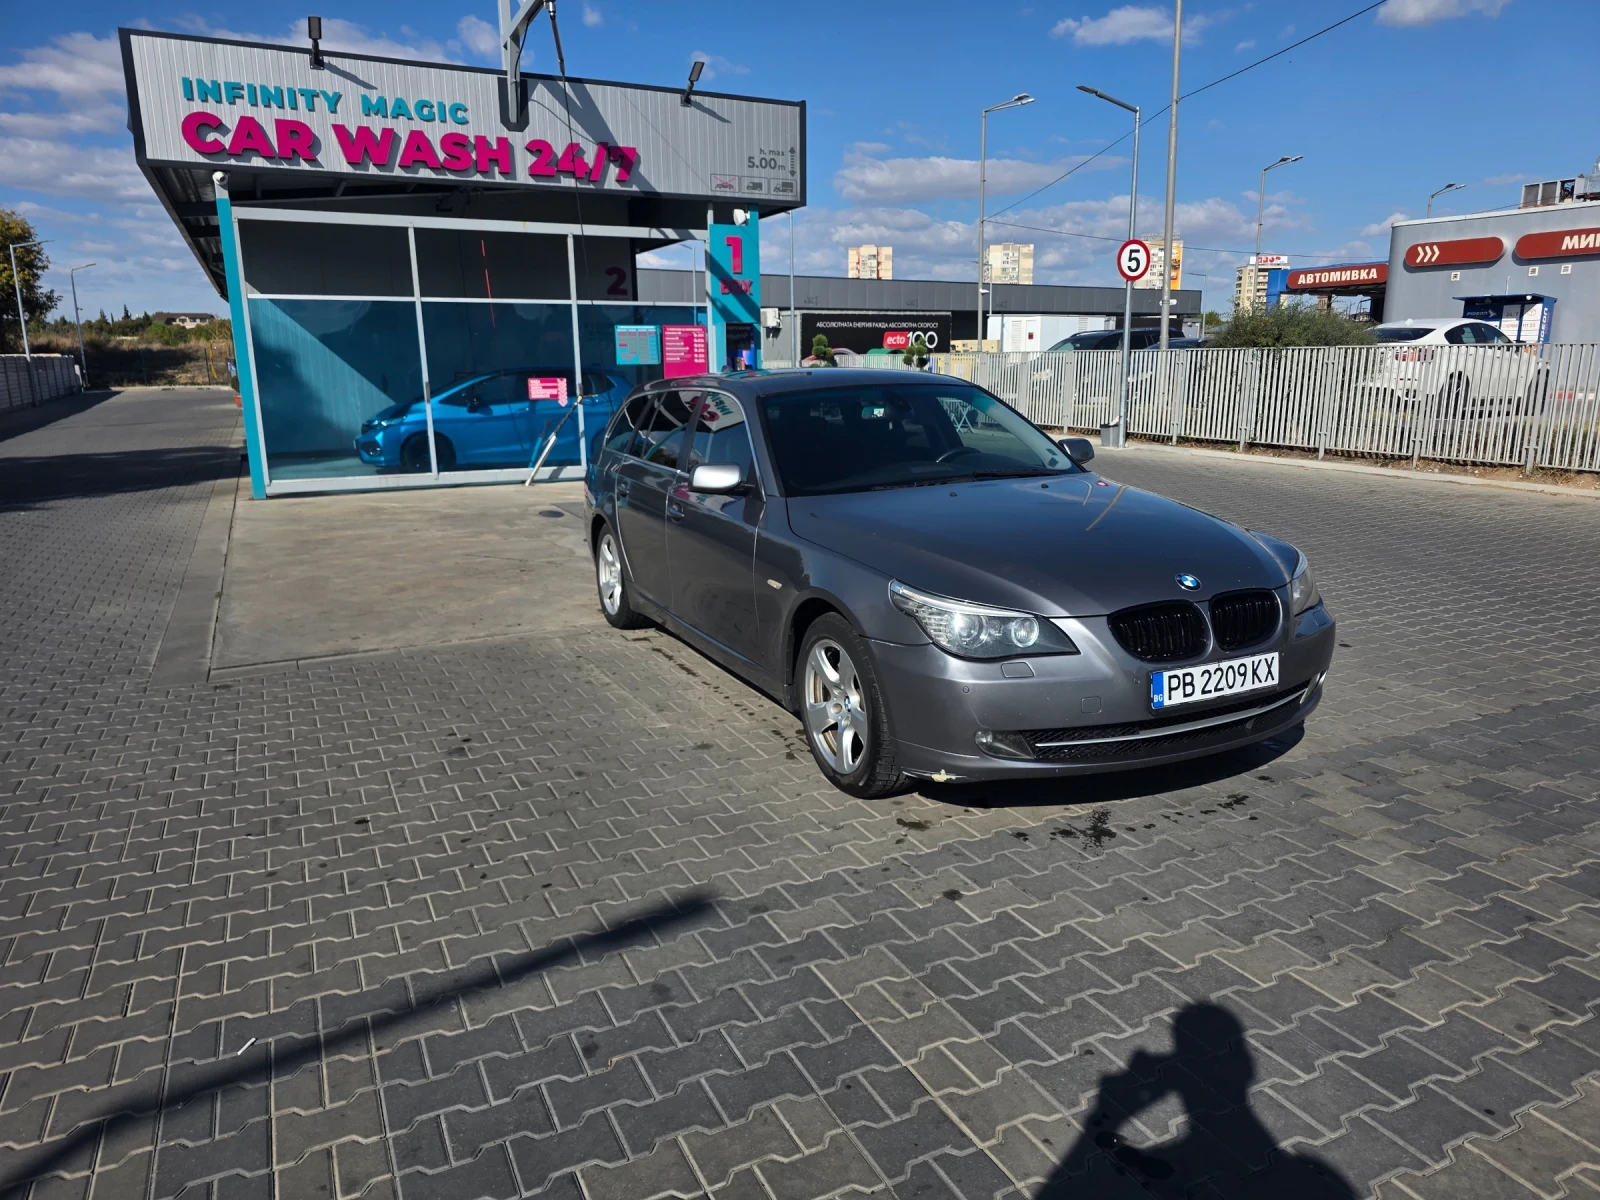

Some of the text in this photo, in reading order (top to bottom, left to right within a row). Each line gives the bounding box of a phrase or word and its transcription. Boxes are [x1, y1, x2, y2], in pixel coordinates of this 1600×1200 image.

[182, 77, 468, 123] INFINITY MAGIC
[181, 111, 637, 181] CAR WASH 24/7
[769, 149, 785, 157] max
[725, 236, 743, 274] 1
[1127, 249, 1140, 273] 5
[605, 265, 629, 296] 2
[720, 279, 752, 295] BOX
[1298, 268, 1377, 285] АВТОМИВКА
[1168, 656, 1275, 700] PB 2209 KX
[1153, 694, 1163, 702] BG
